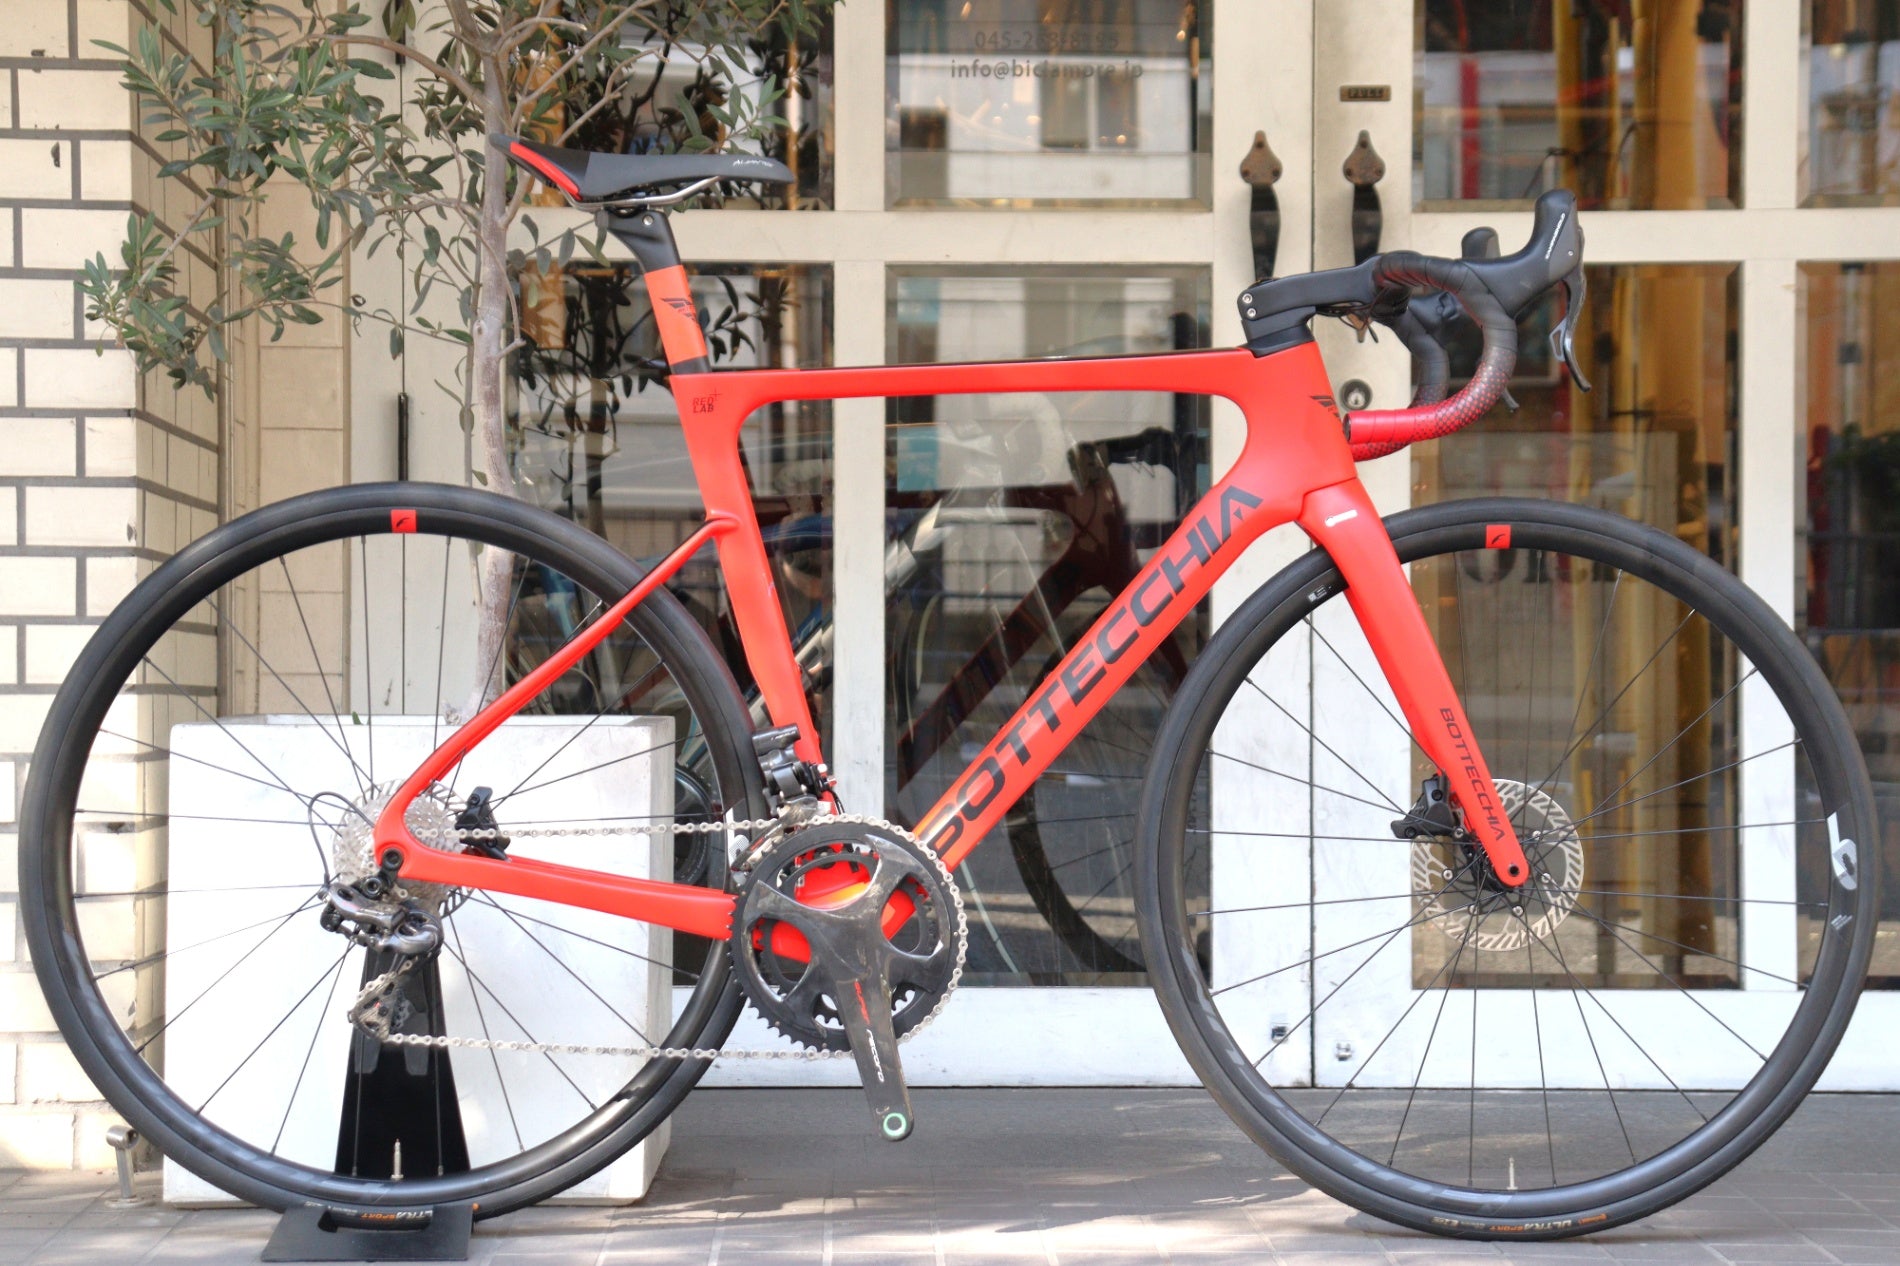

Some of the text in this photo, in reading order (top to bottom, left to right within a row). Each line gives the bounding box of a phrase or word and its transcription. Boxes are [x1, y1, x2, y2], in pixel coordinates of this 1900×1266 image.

[693, 404, 714, 413] LAB
[917, 486, 1263, 853] BOTTECCHIA
[1440, 707, 1506, 842] BOTTECCHIA
[1524, 1219, 1573, 1231] ULTRA
